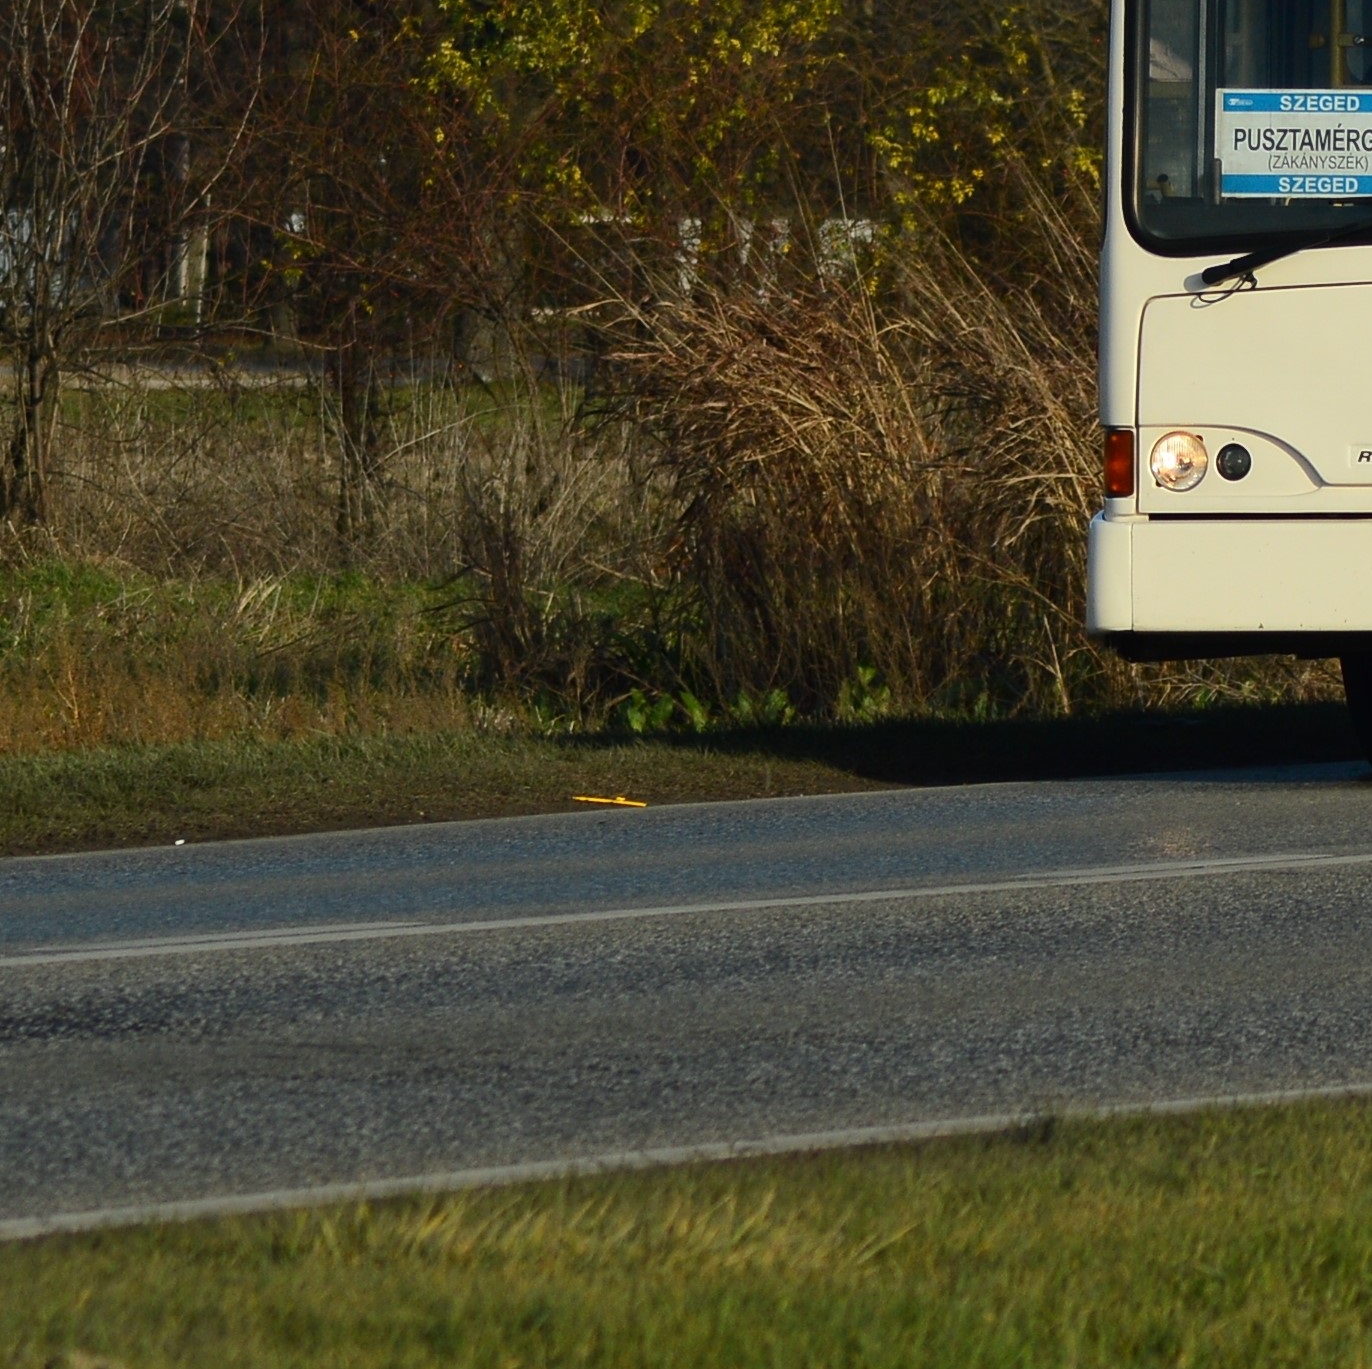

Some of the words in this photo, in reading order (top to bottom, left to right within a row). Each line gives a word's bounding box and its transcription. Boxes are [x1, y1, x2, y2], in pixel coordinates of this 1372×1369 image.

[1280, 95, 1360, 112] SZEGED
[1268, 152, 1369, 172] (ZÁKÁNYSZÉK)
[1278, 177, 1359, 193] SZEGED
